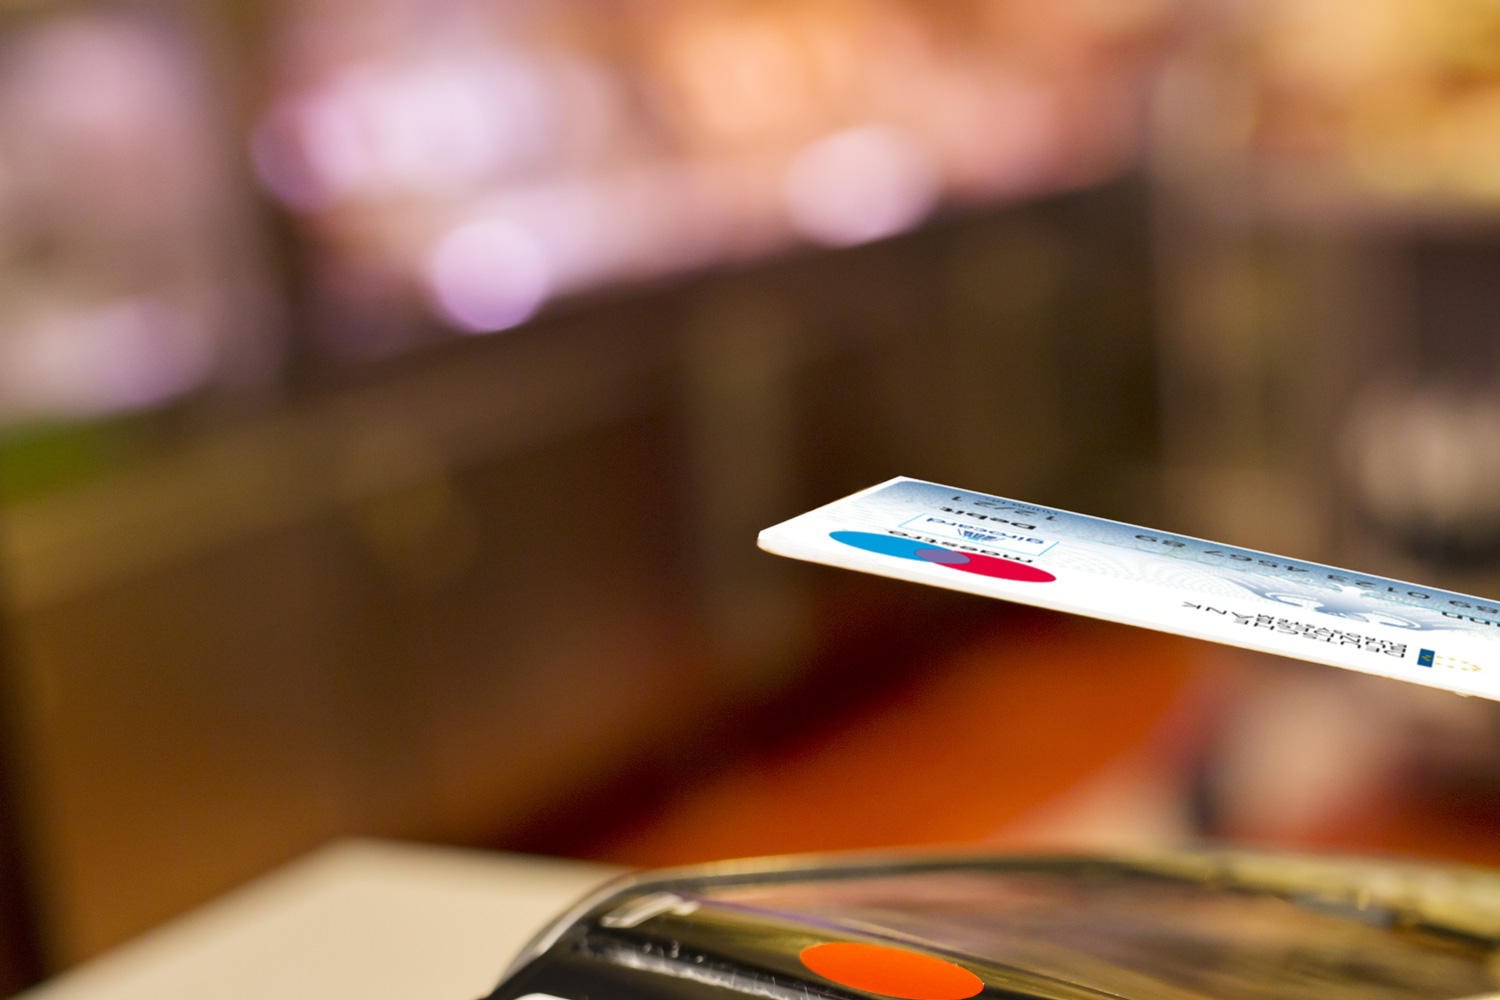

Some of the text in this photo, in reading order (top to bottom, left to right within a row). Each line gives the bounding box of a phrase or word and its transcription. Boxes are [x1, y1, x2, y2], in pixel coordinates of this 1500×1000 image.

[939, 505, 1036, 530] Debit
[952, 495, 1055, 521] 12/21
[925, 516, 1045, 545] girocard
[1134, 533, 1186, 549] 89
[887, 529, 1033, 563] maestro
[1202, 548, 1309, 574] 4567
[1326, 573, 1431, 600] 0123
[1181, 600, 1407, 653] BUNDESBANK
[1232, 618, 1405, 659] DEUTSCHE
